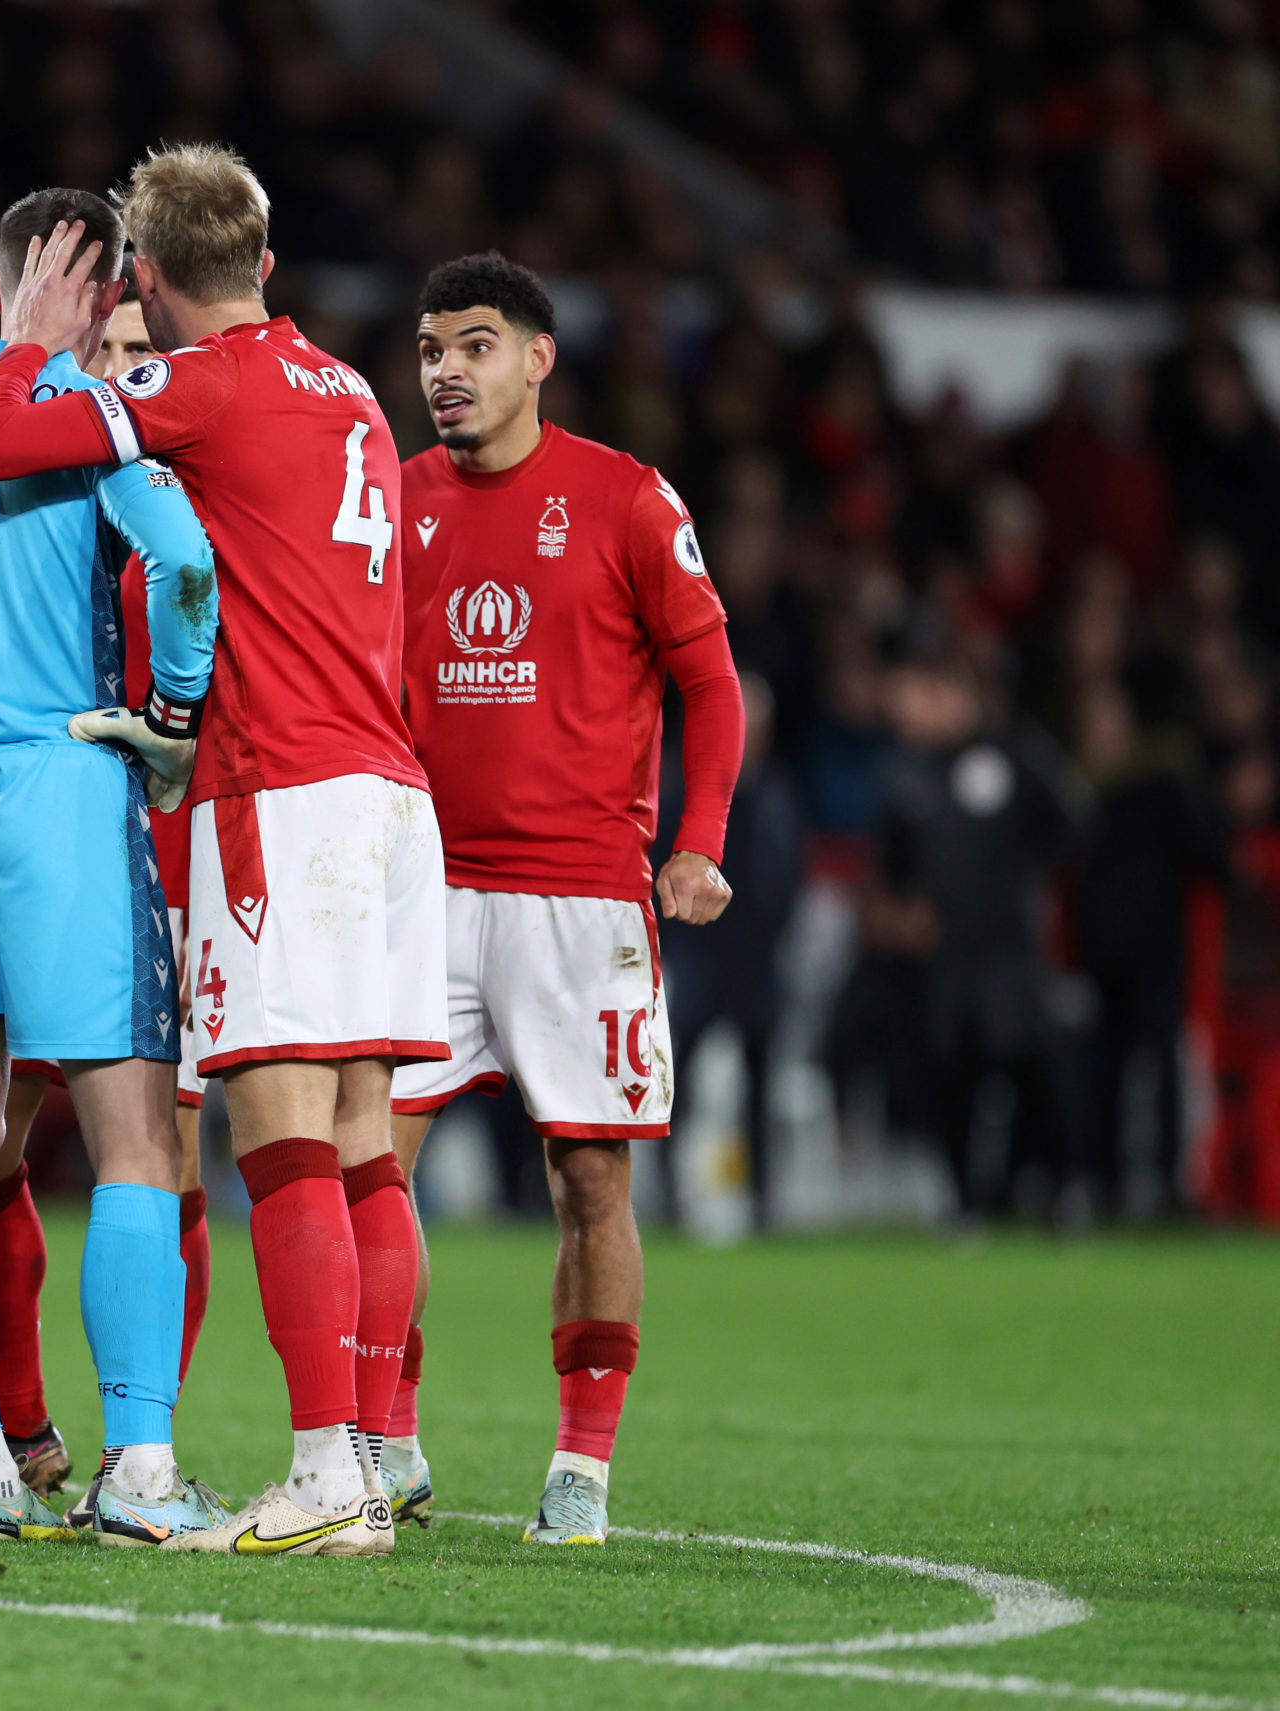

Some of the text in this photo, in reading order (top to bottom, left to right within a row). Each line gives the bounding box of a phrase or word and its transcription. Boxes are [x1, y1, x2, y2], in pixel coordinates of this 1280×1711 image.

[331, 420, 393, 586] 4
[438, 661, 537, 684] UNHCR
[437, 695, 537, 705] United Kingdom for UNHCR
[438, 685, 537, 695] The UN Refugee Agency
[195, 939, 227, 1009] 4
[98, 1382, 129, 1399] FFC
